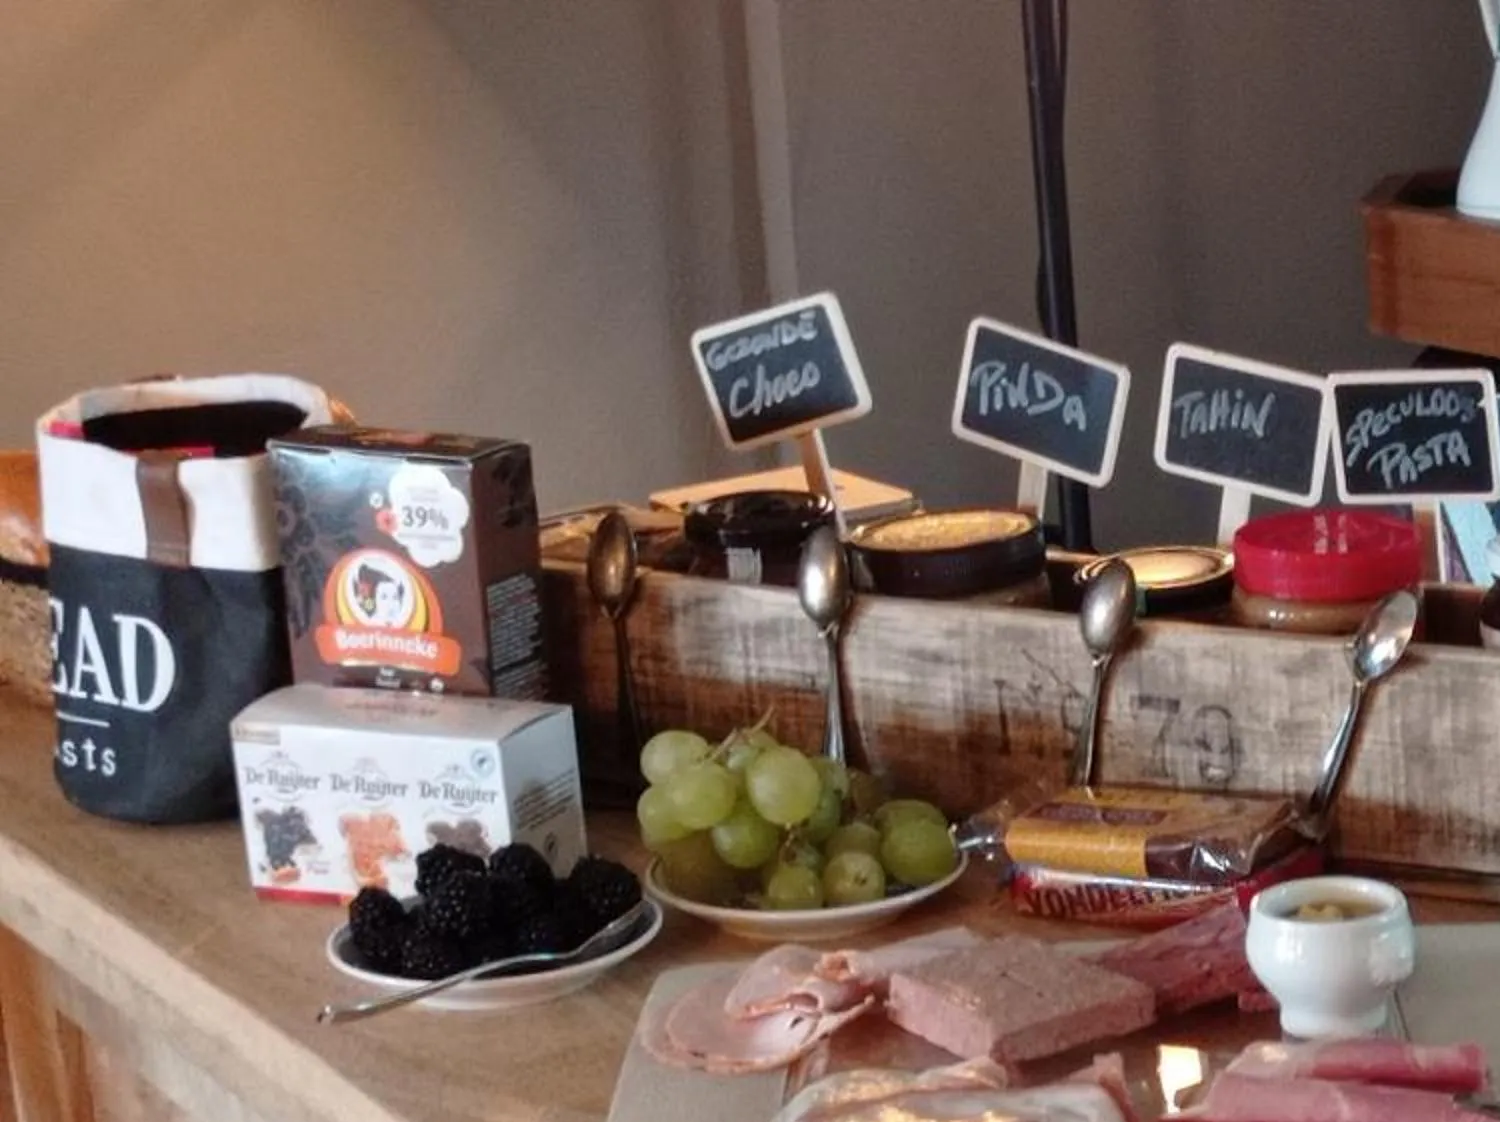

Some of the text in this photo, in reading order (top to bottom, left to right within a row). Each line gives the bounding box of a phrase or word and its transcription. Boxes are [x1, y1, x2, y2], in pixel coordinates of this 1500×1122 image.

[402, 505, 450, 530] 39%
[54, 738, 117, 777] sts
[245, 766, 265, 785] De
[329, 773, 351, 791] De
[418, 780, 440, 800] De
